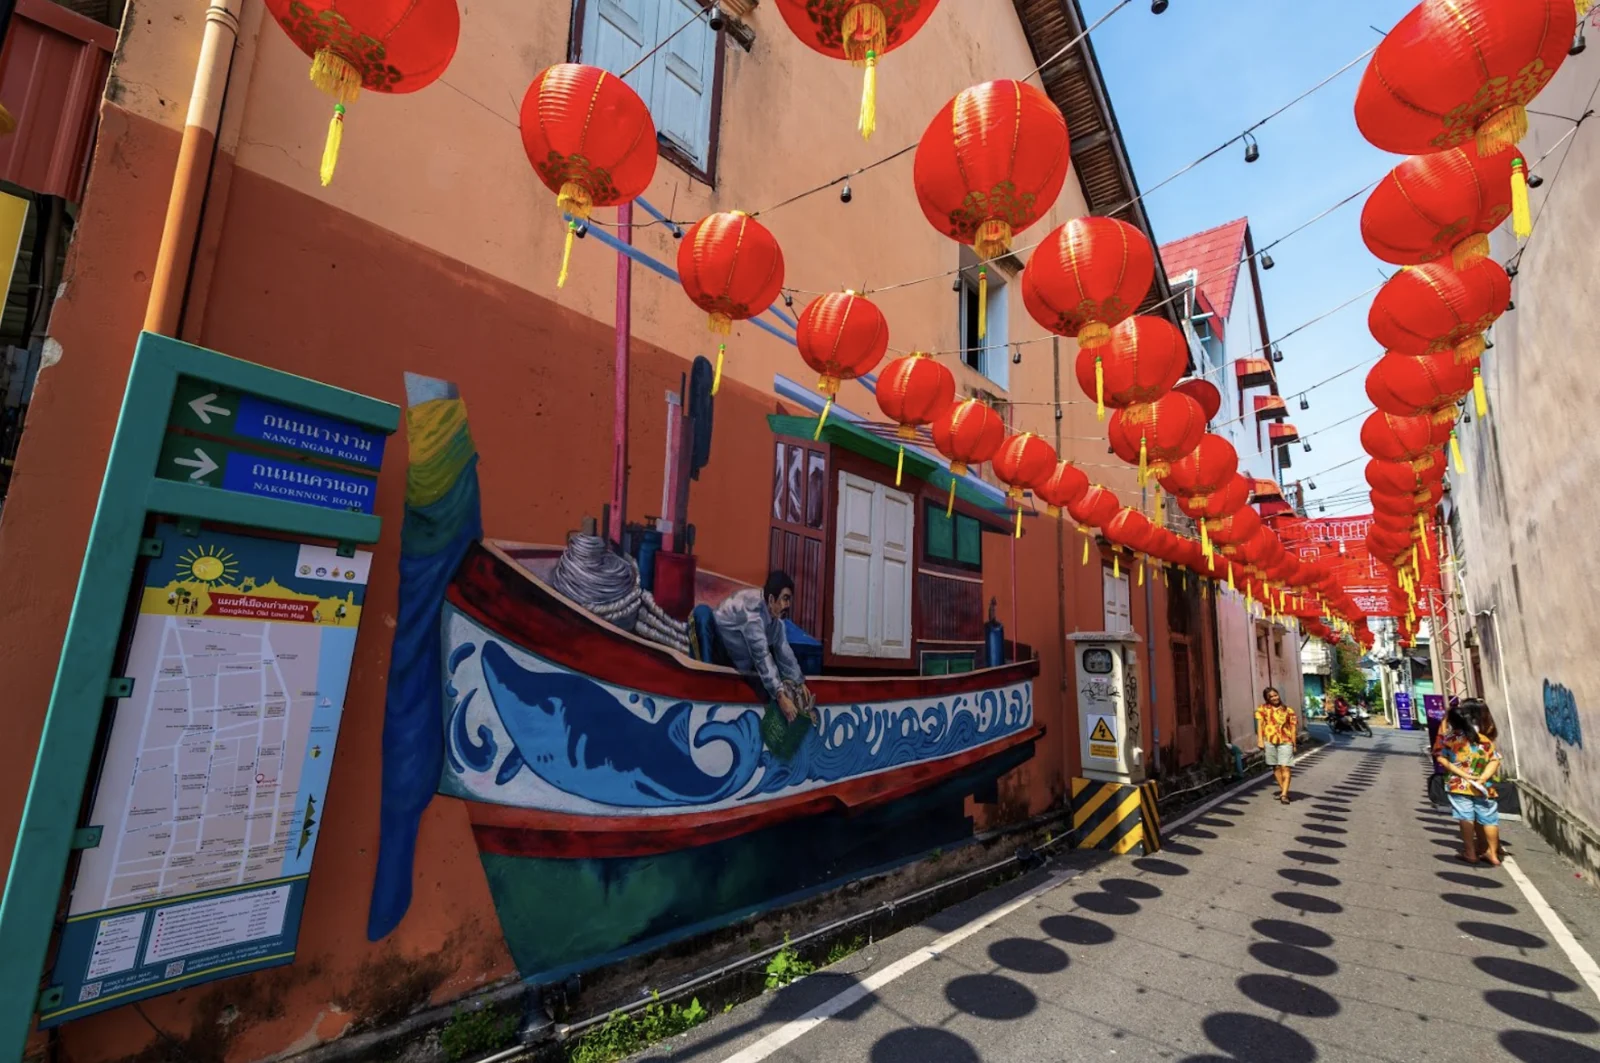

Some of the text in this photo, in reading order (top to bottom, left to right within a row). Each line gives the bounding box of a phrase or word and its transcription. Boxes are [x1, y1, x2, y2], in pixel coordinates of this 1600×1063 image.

[263, 432, 367, 462] NANG NGAM ROAD
[264, 415, 371, 450] ถนนนางงาม
[253, 464, 369, 496] ถนนนครนอก
[254, 482, 362, 508] NAKORNNOK ROAD
